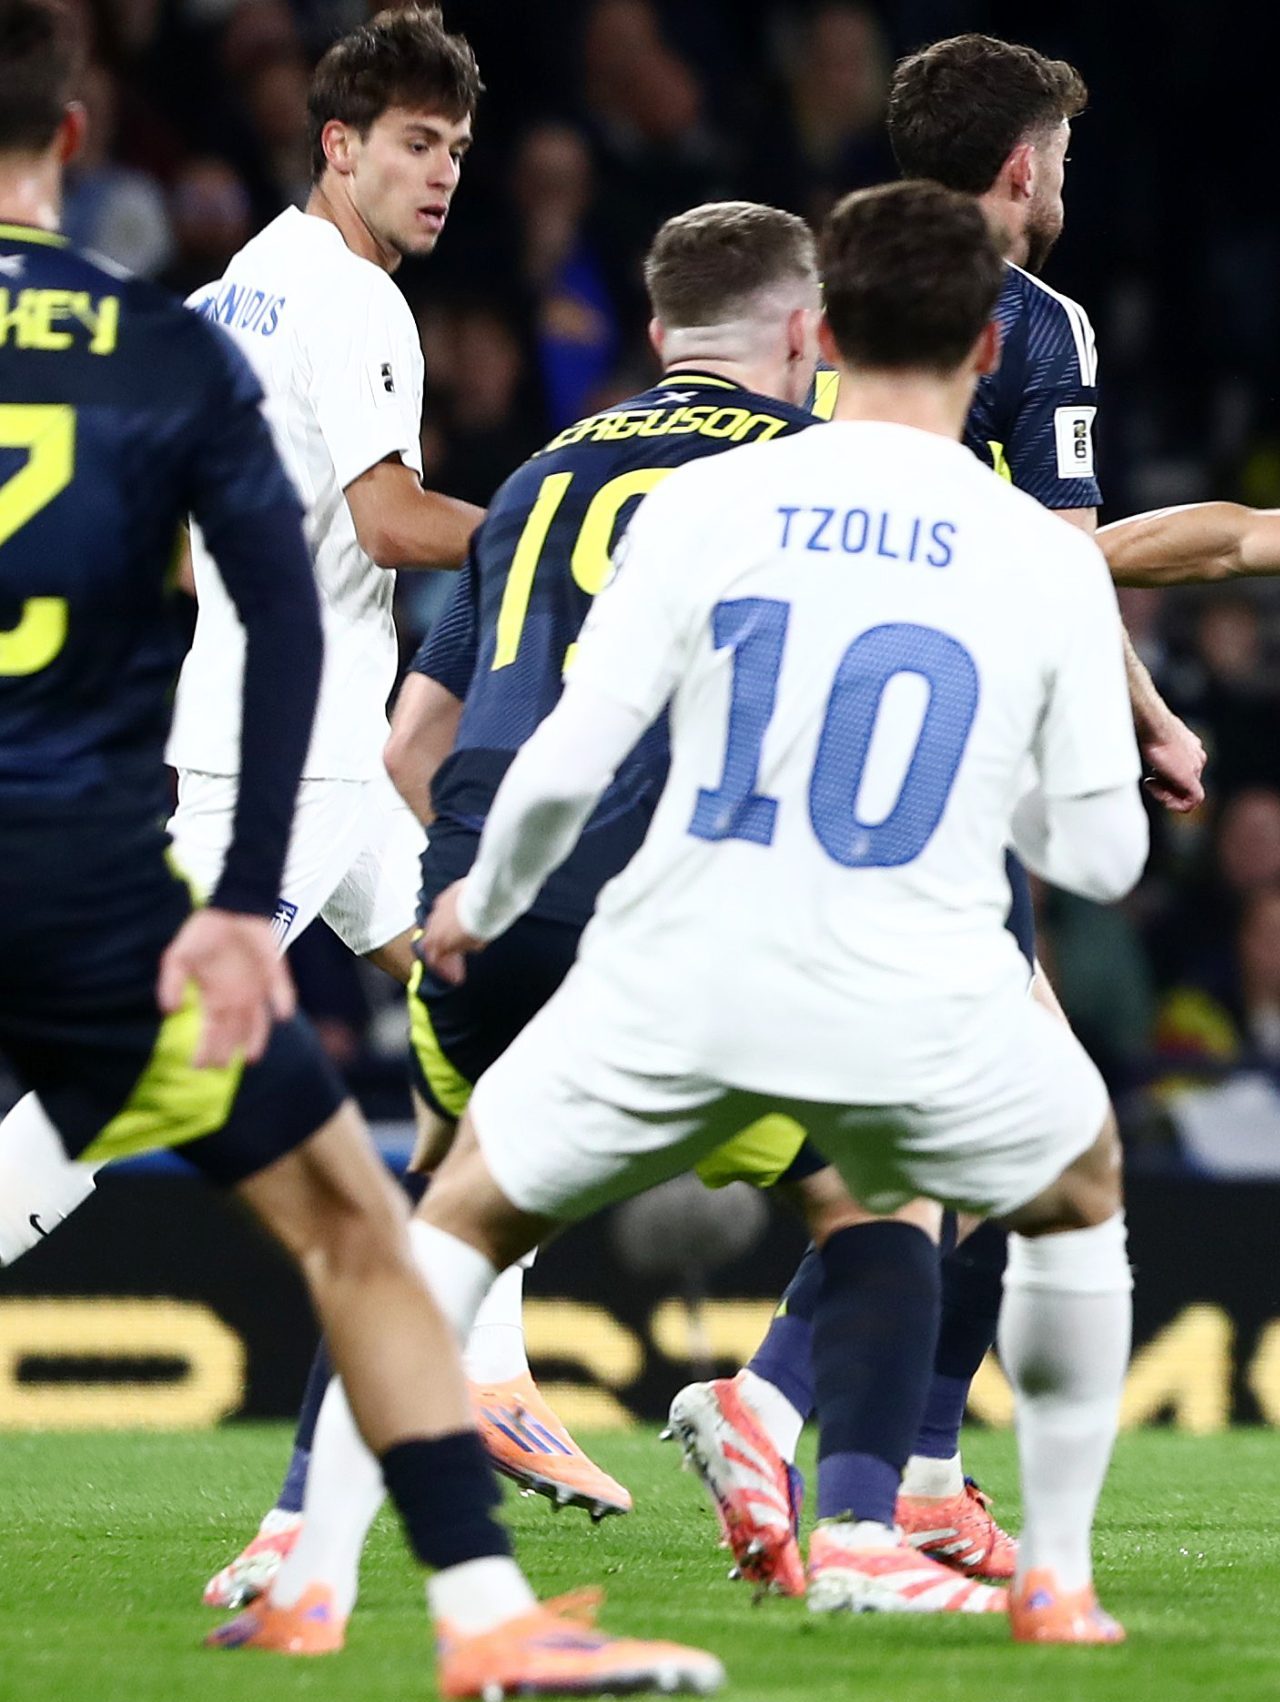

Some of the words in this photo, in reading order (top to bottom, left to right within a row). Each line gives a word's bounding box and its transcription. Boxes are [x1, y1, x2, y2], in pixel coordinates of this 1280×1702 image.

[530, 406, 789, 457] ERGUSON
[777, 507, 956, 568] TZOLIS
[687, 597, 979, 868] 10
